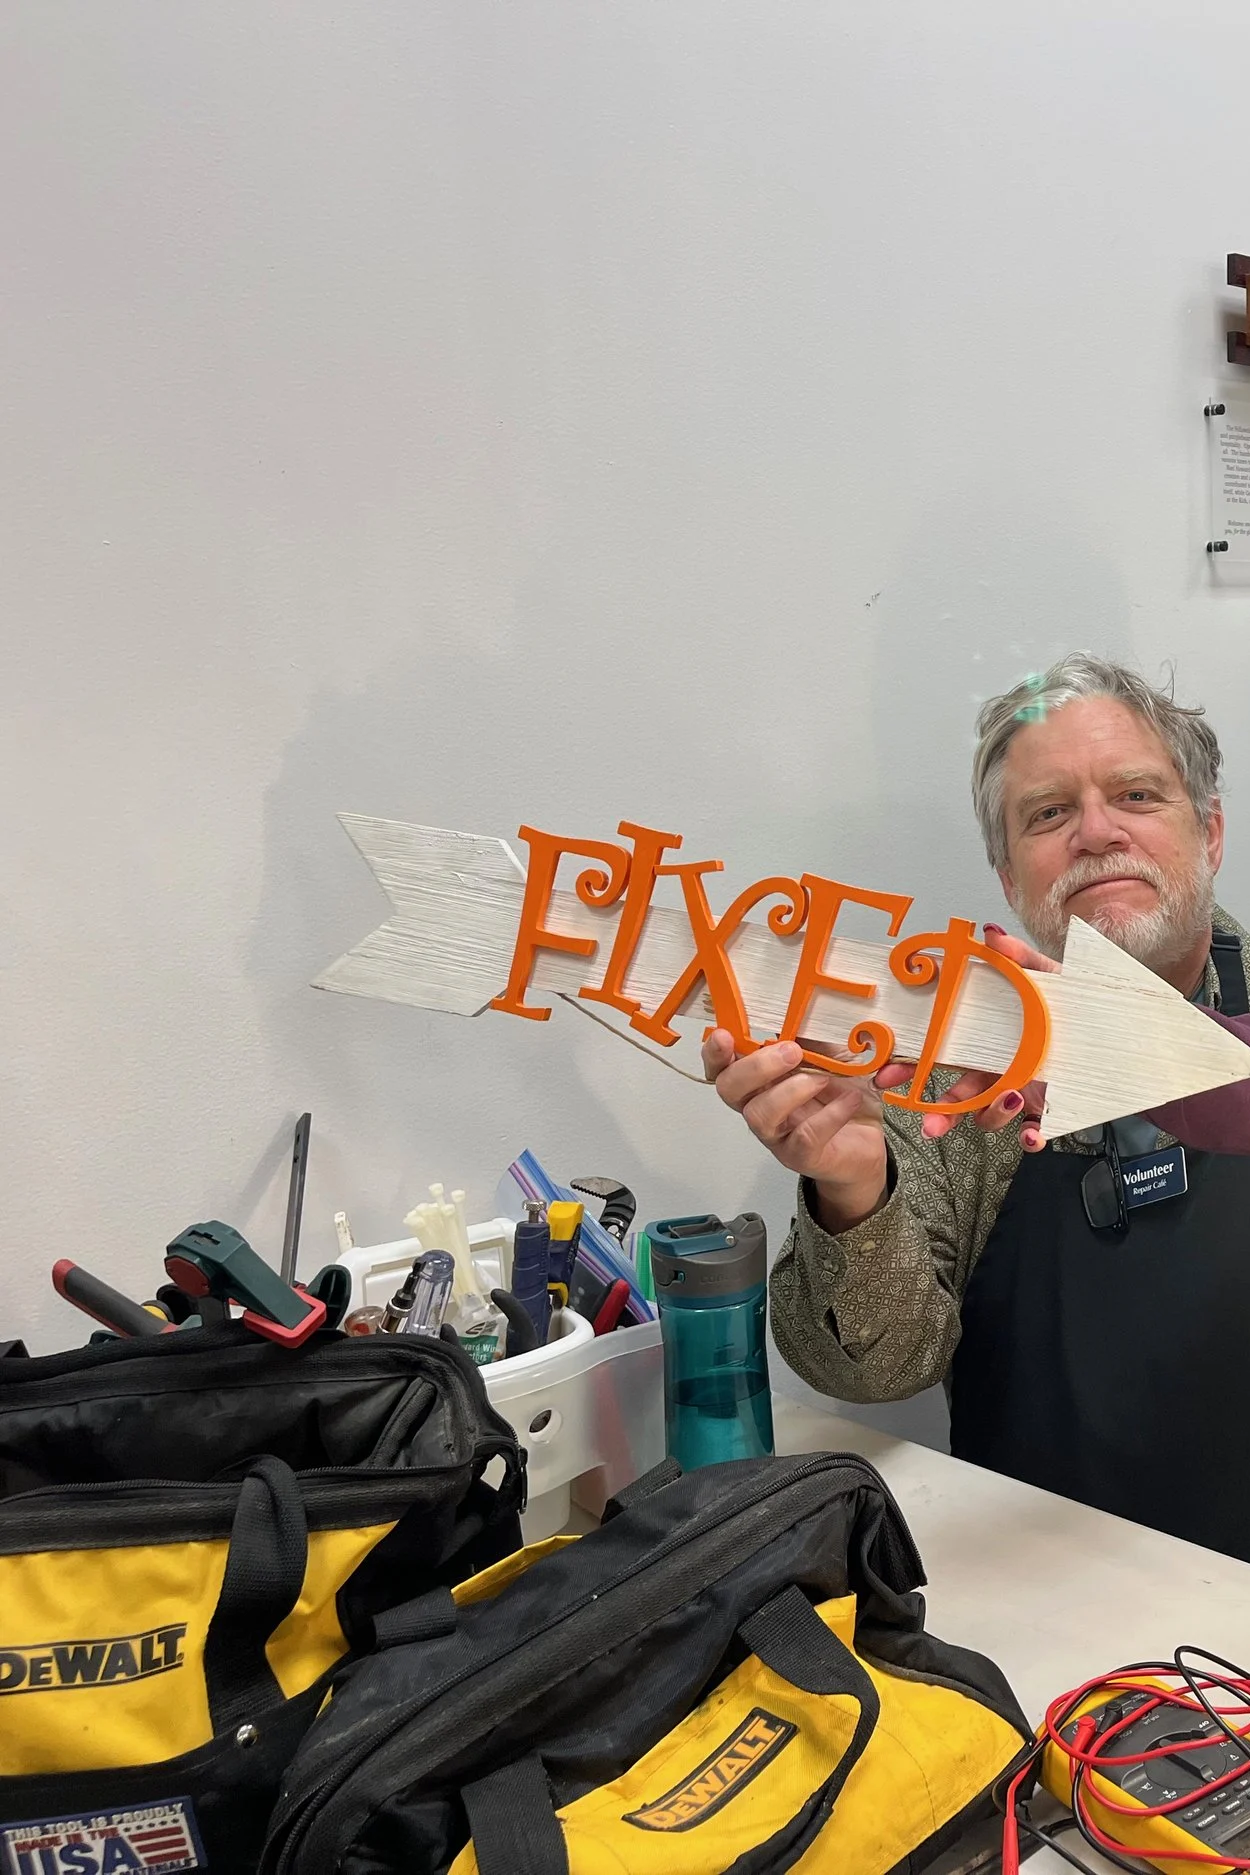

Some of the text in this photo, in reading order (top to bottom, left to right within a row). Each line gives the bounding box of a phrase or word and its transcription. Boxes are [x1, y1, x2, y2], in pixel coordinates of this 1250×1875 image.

[490, 819, 1051, 1115] FIXED
[1123, 1162, 1174, 1186] Volunteer
[1133, 1179, 1167, 1196] Repair Café
[5, 1802, 183, 1842] THIS TOOL IS PROUDLY
[15, 1826, 120, 1852] MADE IN THE
[17, 1836, 143, 1875] USA
